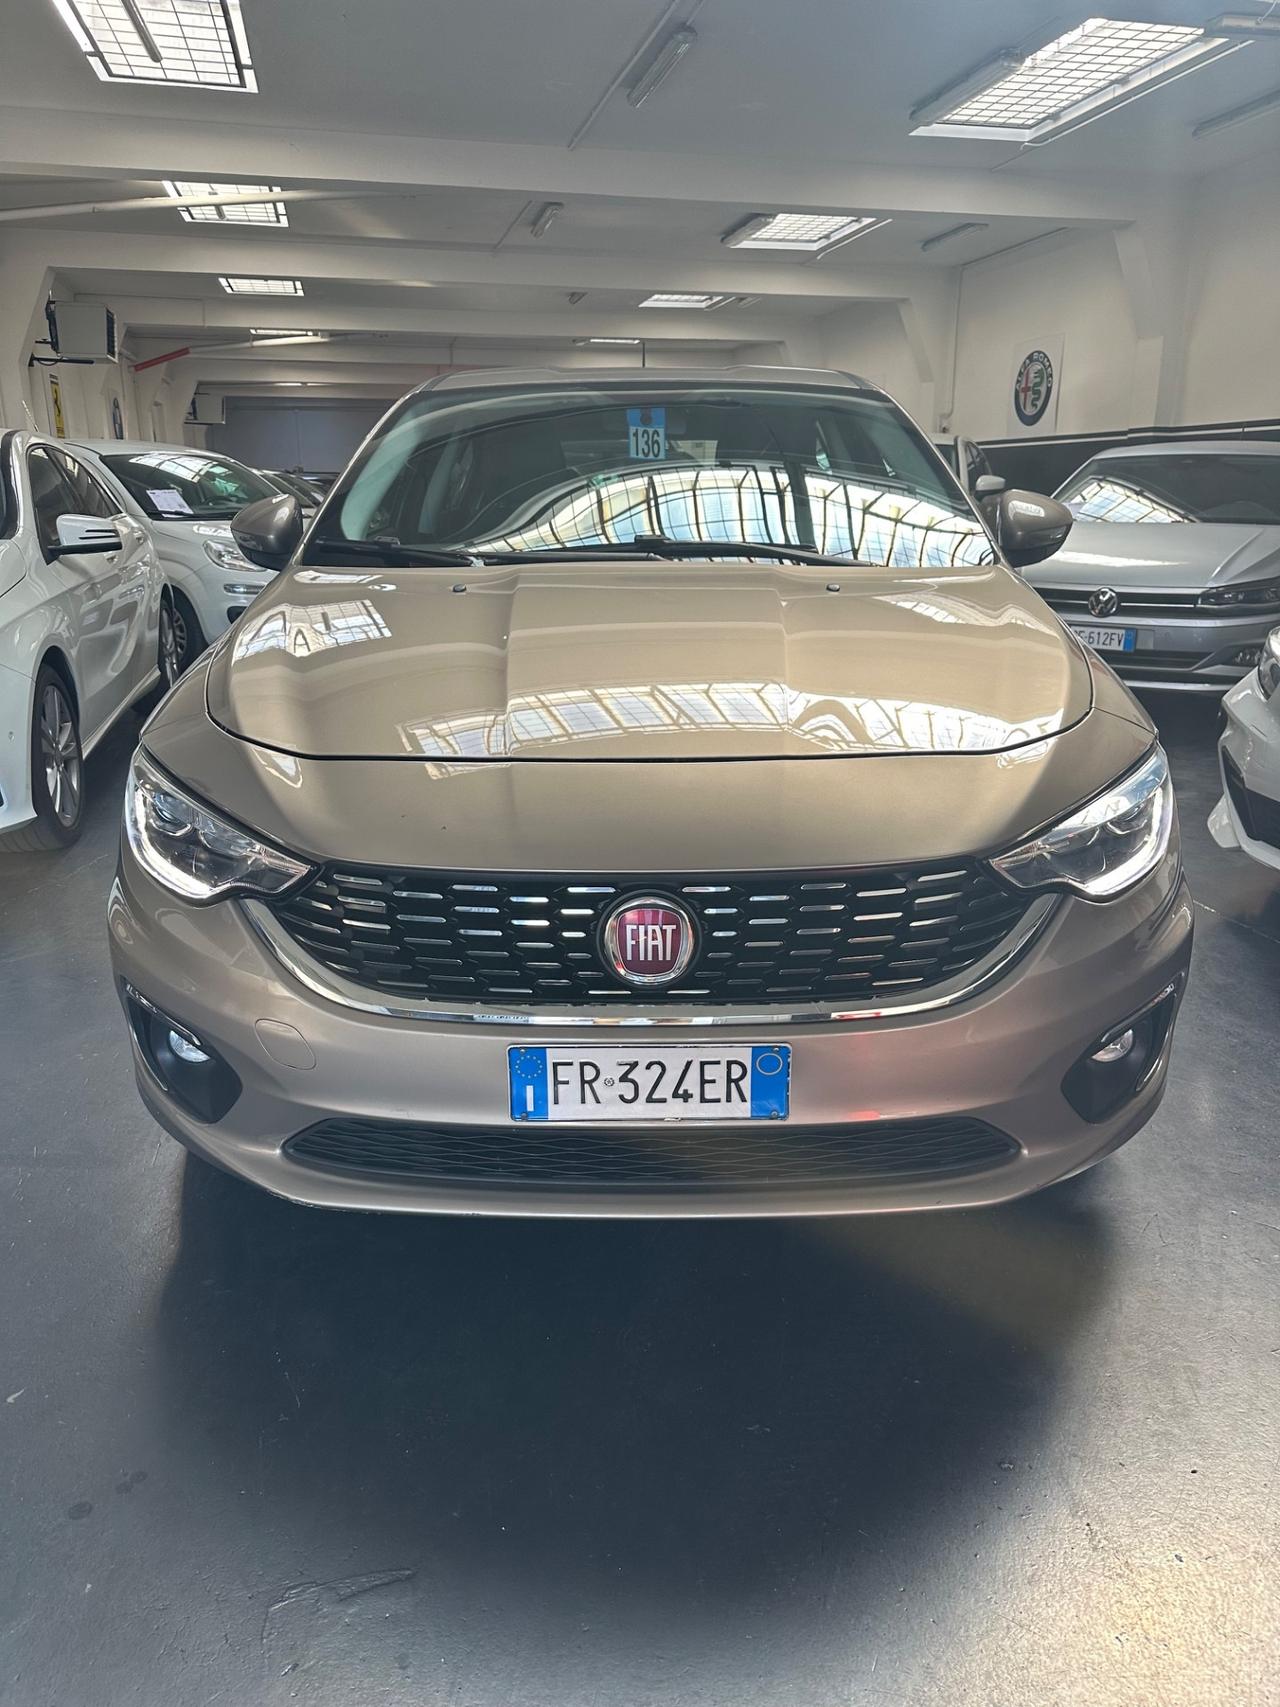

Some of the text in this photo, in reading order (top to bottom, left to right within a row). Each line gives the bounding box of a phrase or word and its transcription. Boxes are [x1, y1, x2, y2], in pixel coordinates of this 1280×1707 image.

[1033, 352, 1052, 388] ROMEO
[632, 428, 661, 458] 136
[625, 924, 677, 961] FIAT
